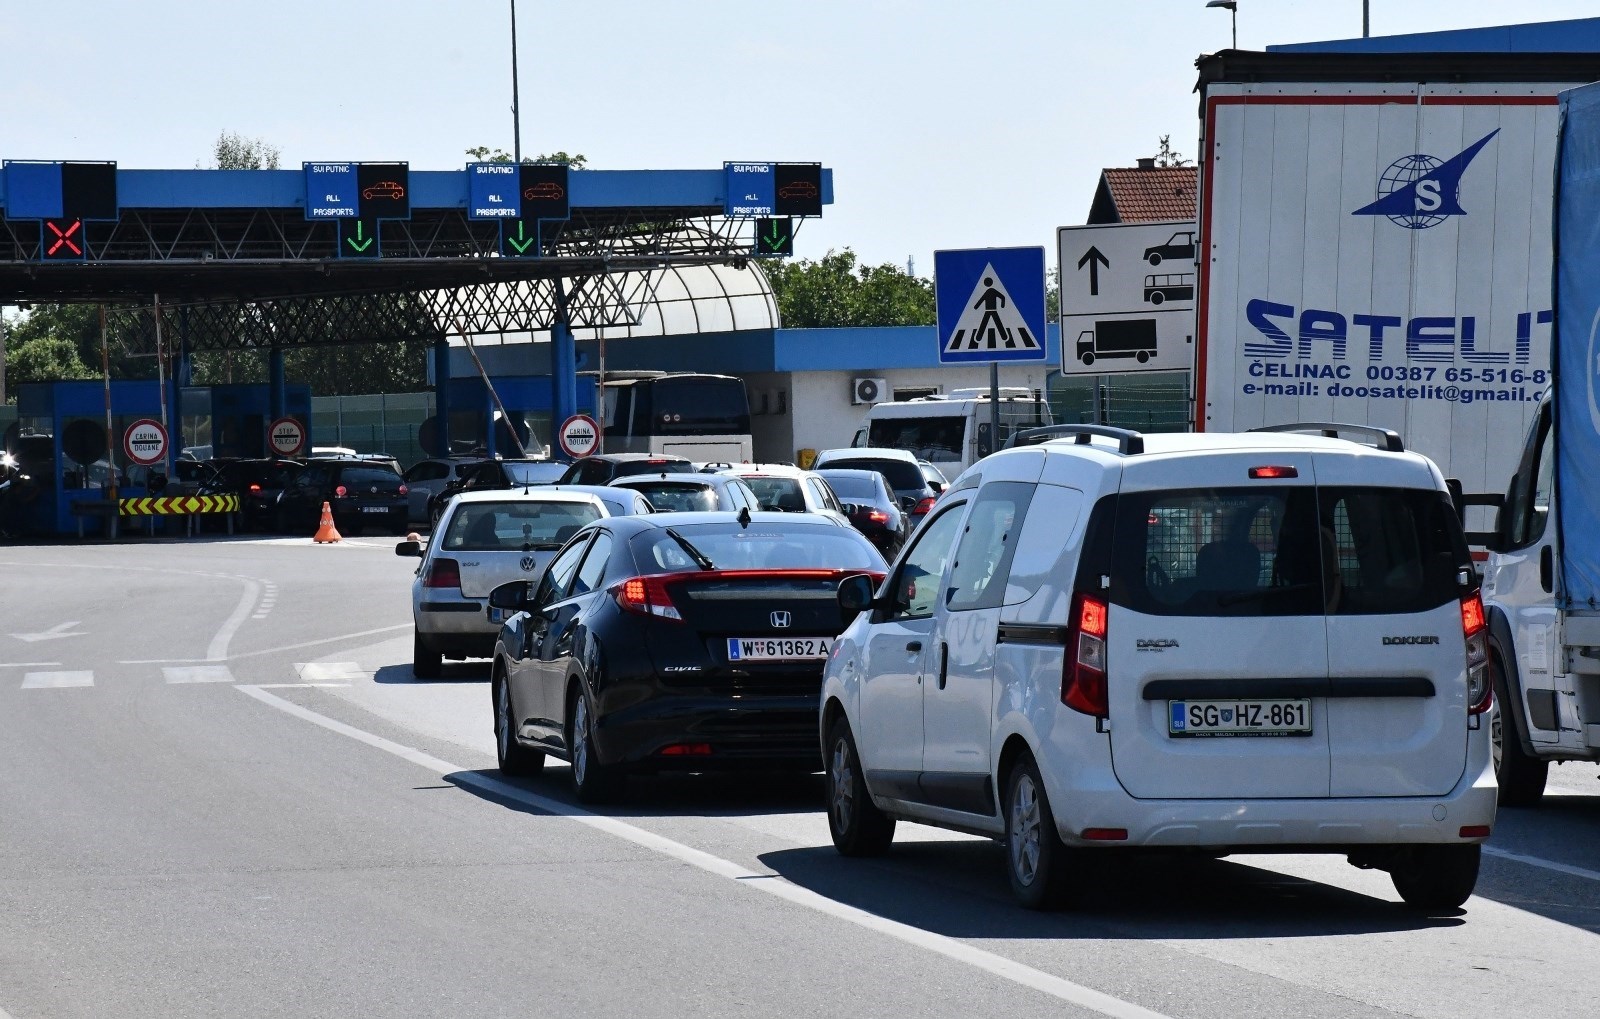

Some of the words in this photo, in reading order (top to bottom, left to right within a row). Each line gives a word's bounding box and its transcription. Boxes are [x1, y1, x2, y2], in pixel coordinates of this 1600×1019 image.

[476, 166, 488, 174] SVI
[488, 166, 514, 174] PUTNICI
[733, 165, 745, 173] SVI
[745, 165, 769, 173] PUTNICI
[326, 194, 341, 202] ALL
[488, 194, 503, 202] ALL
[1414, 179, 1442, 211] S
[313, 208, 355, 216] PASSPORTS
[476, 208, 516, 216] PASSPORTS
[1248, 360, 1351, 379] ČELINAC
[1366, 366, 1437, 382] 00387
[1445, 367, 1552, 384] 65-516-8
[1243, 382, 1319, 396] e-mail:
[135, 432, 158, 440] CARINA
[569, 438, 591, 446] DOUANE
[134, 444, 160, 452] DOUANE
[1136, 638, 1180, 648] DACIA
[1382, 635, 1440, 645] DOKKER
[742, 641, 753, 656] W
[766, 640, 815, 656] 61362
[818, 641, 830, 655] A
[1189, 704, 1219, 727] SG
[1235, 703, 1304, 727] HZ-861
